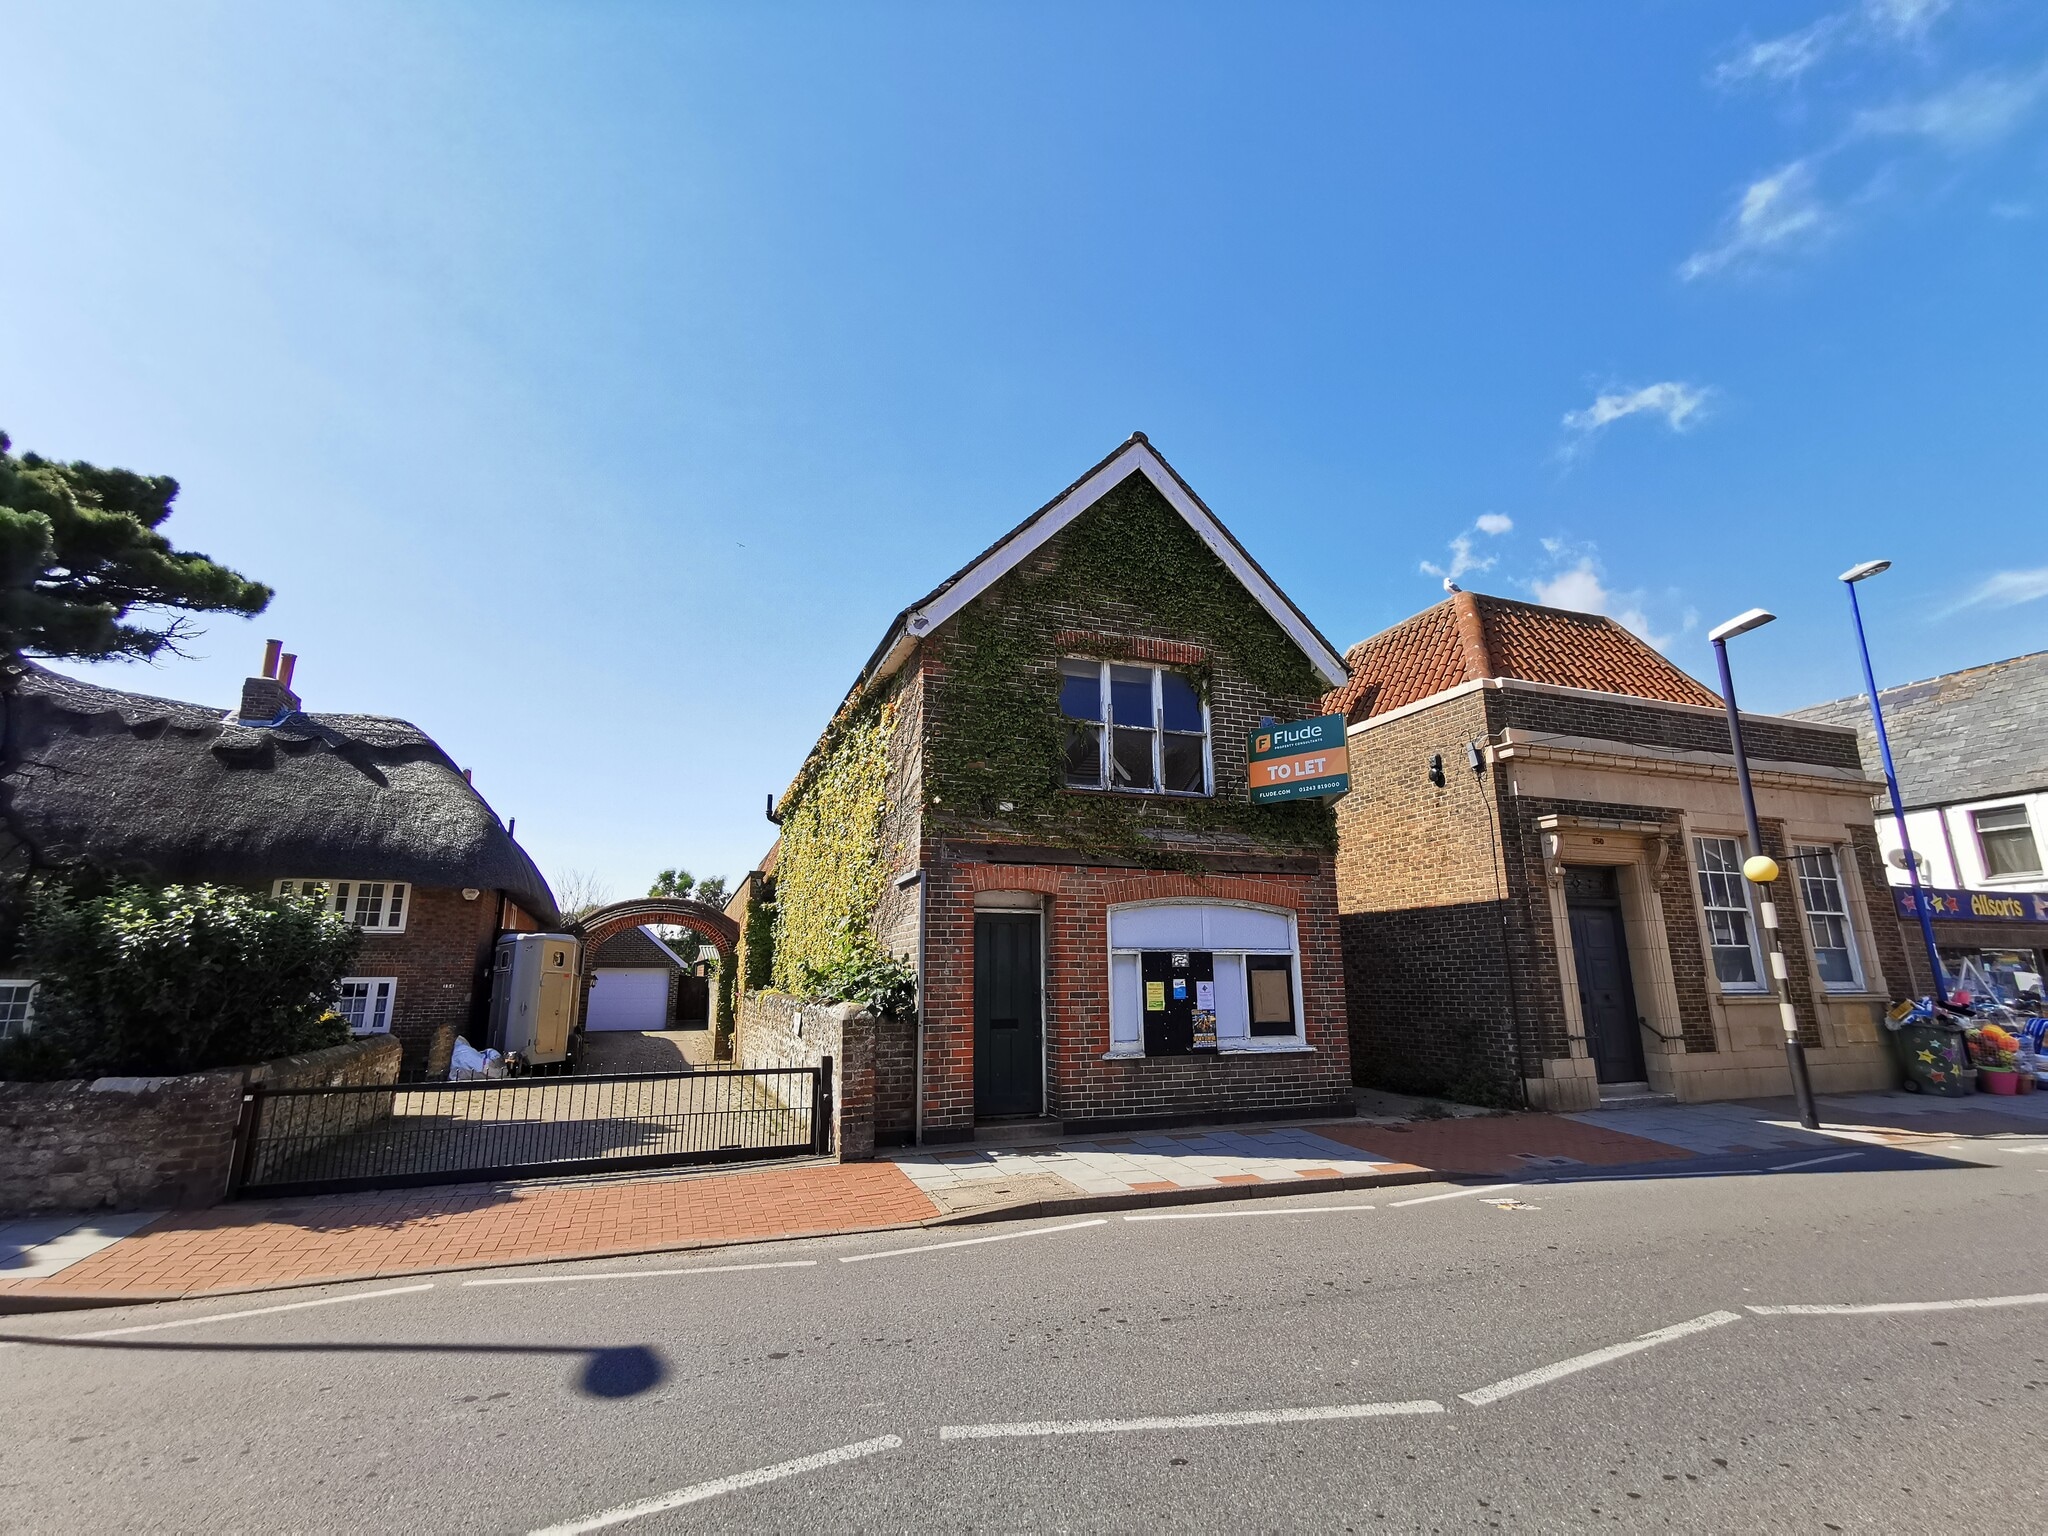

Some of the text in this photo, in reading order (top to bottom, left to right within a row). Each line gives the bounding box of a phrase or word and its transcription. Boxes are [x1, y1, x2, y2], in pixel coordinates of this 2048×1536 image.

[1274, 725, 1322, 744] Flude
[1267, 757, 1326, 780] TO LET
[1259, 789, 1291, 798] FLUDE.COM
[1298, 785, 1316, 793] 01243
[1971, 894, 2023, 917] Allsorts
